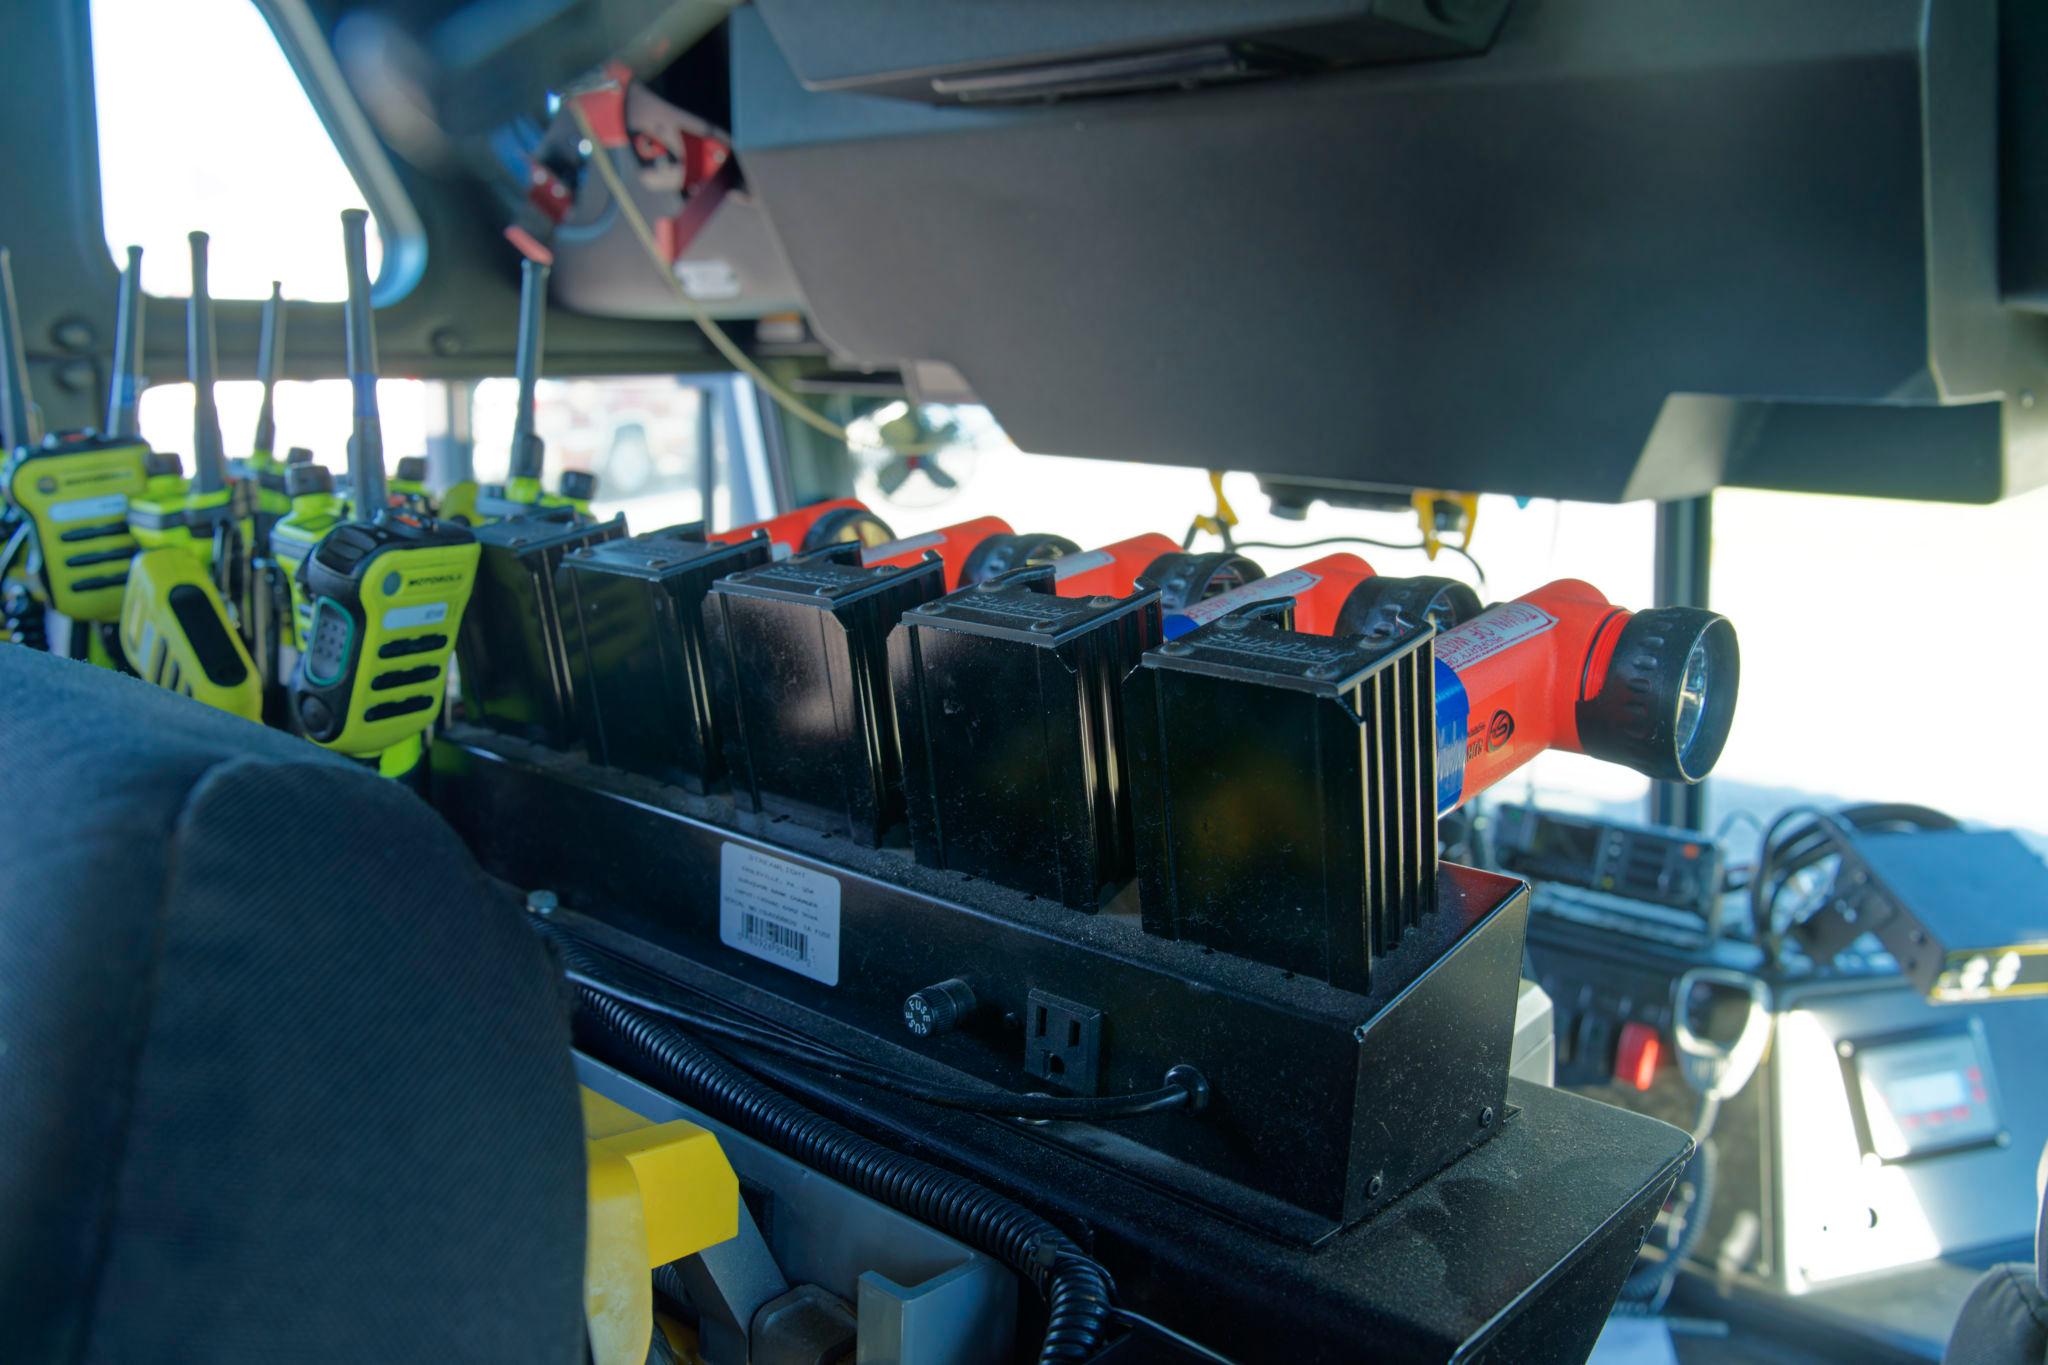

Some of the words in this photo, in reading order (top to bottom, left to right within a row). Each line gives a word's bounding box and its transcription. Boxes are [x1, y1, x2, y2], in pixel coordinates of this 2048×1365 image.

[408, 573, 463, 586] MOTOROLA
[908, 999, 931, 1022] FUSE
[905, 1011, 928, 1034] FUSE
